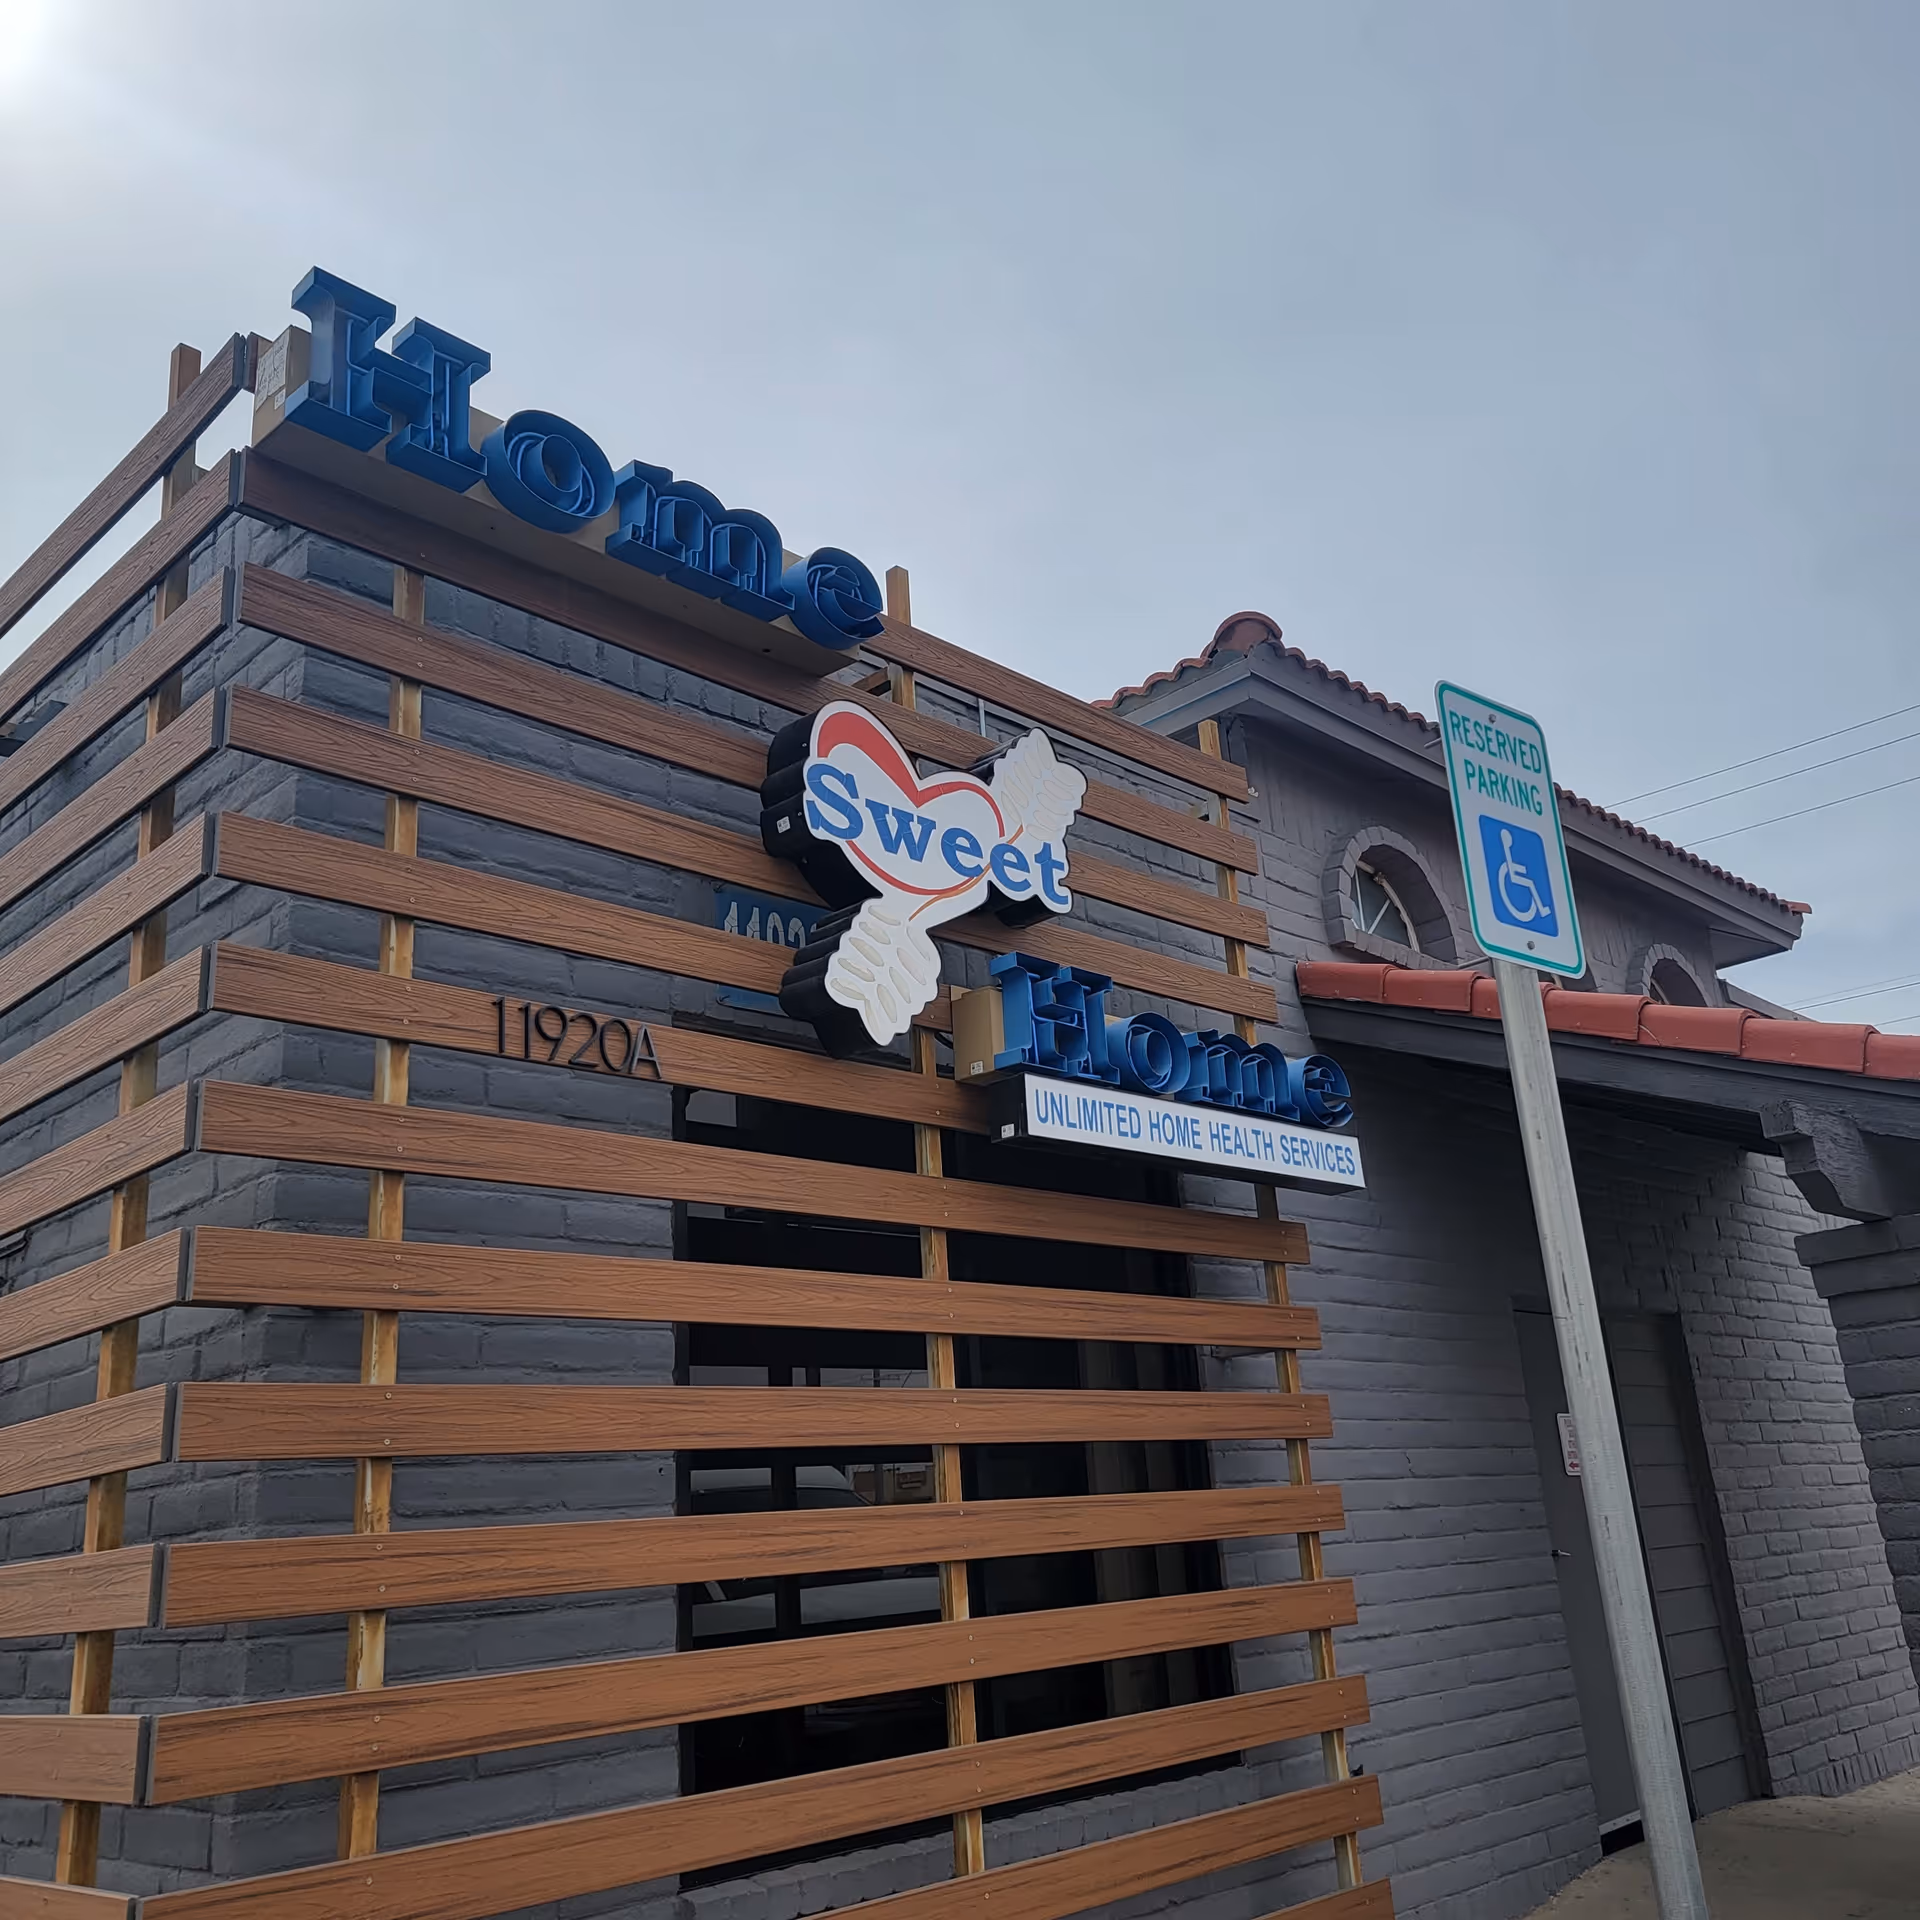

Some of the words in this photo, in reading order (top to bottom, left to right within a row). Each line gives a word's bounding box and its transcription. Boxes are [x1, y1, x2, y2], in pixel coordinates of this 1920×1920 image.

[284, 265, 886, 650] Home
[1448, 709, 1542, 774] RESERVED
[1463, 758, 1544, 816] PARKING
[804, 762, 1070, 906] Sweet
[491, 995, 663, 1080] 11920A
[990, 951, 1354, 1128] Home
[1034, 1088, 1142, 1140] UNLIMITED
[1147, 1109, 1204, 1151] HOME
[1208, 1120, 1276, 1163] HEALTH
[1279, 1133, 1357, 1176] SERVICES
